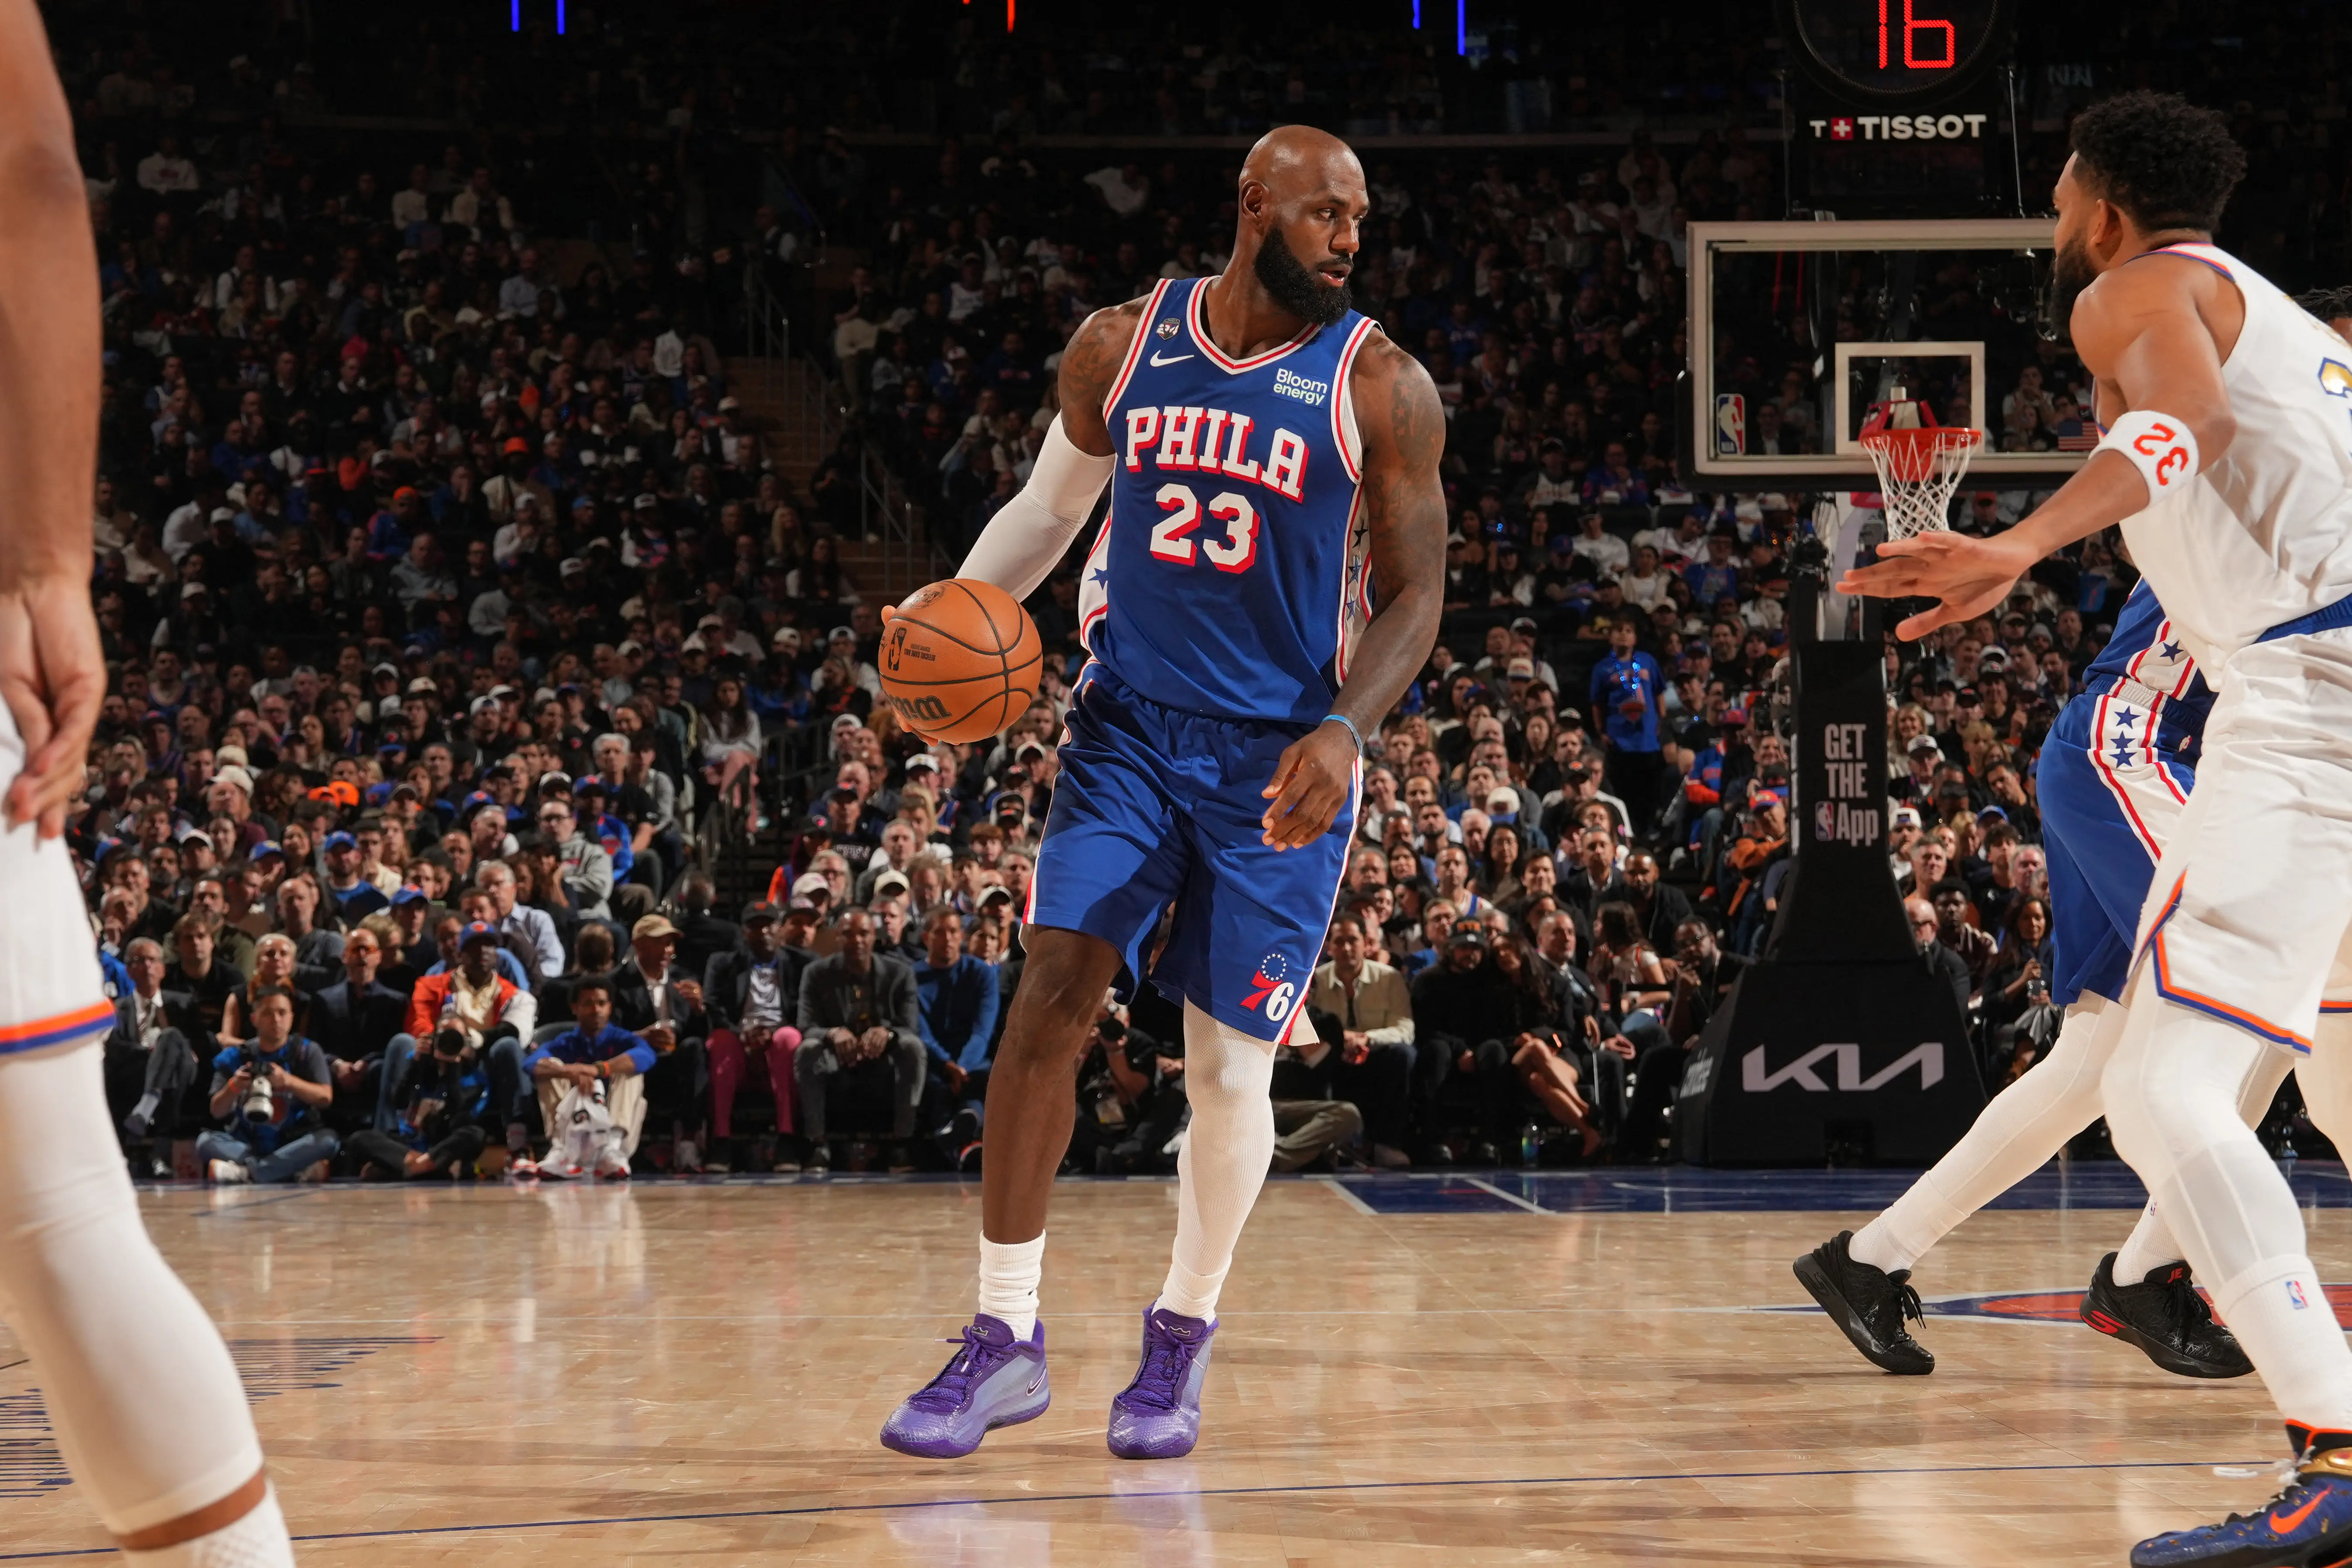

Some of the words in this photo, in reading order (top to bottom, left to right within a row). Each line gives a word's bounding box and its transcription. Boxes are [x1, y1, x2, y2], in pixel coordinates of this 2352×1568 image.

[1879, 0, 1955, 69] 16
[1857, 114, 1987, 140] TISSOT
[1273, 383, 1325, 405] energy
[1276, 368, 1327, 394] Bloom
[1125, 406, 1310, 504] PHILA
[1150, 483, 1260, 574] 23
[911, 650, 920, 658] GAME
[920, 652, 936, 662] OFFICIAL
[1824, 723, 1867, 760] GET
[1824, 762, 1868, 798] THE
[1836, 806, 1879, 847] App
[1240, 970, 1294, 1022] 76
[2167, 1267, 2183, 1283] JE
